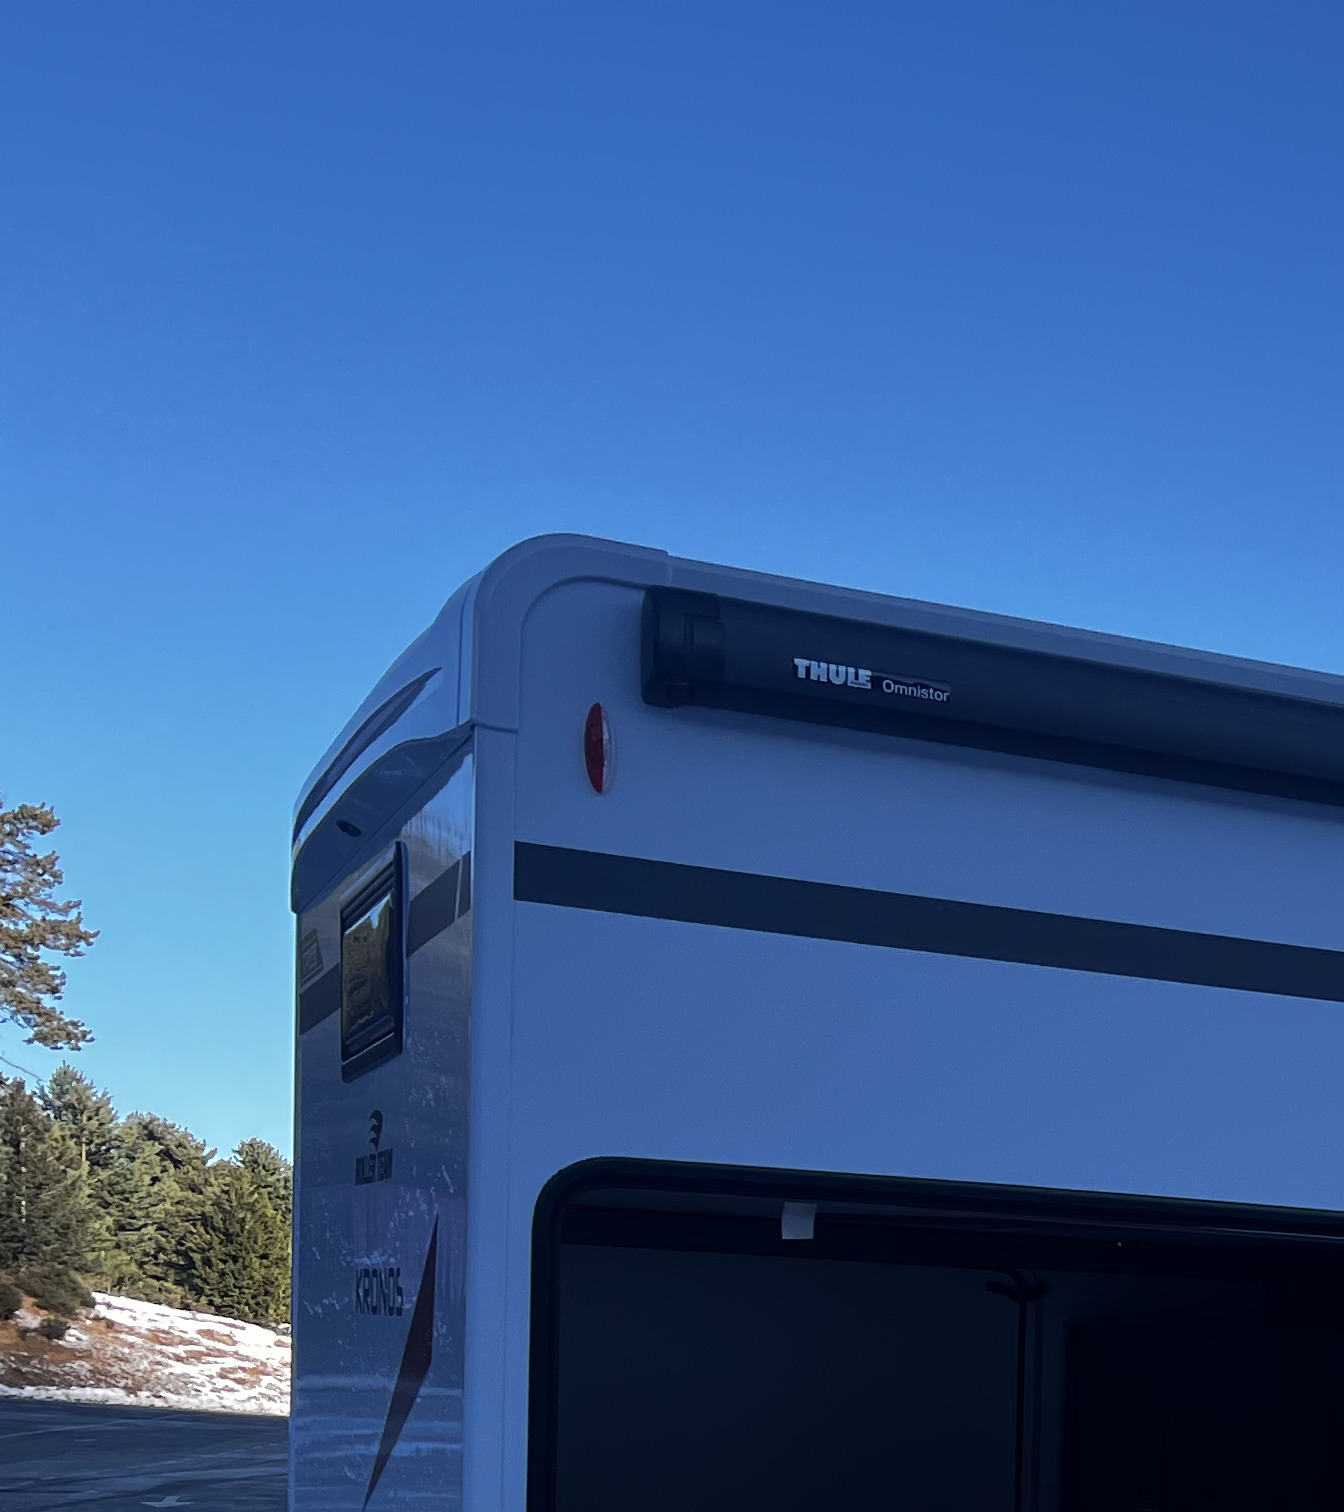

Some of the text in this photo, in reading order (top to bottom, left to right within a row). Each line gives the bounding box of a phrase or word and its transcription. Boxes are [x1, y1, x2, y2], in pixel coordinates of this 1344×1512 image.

[793, 657, 950, 702] THULE Omnistor
[355, 1267, 404, 1316] KRONOS
